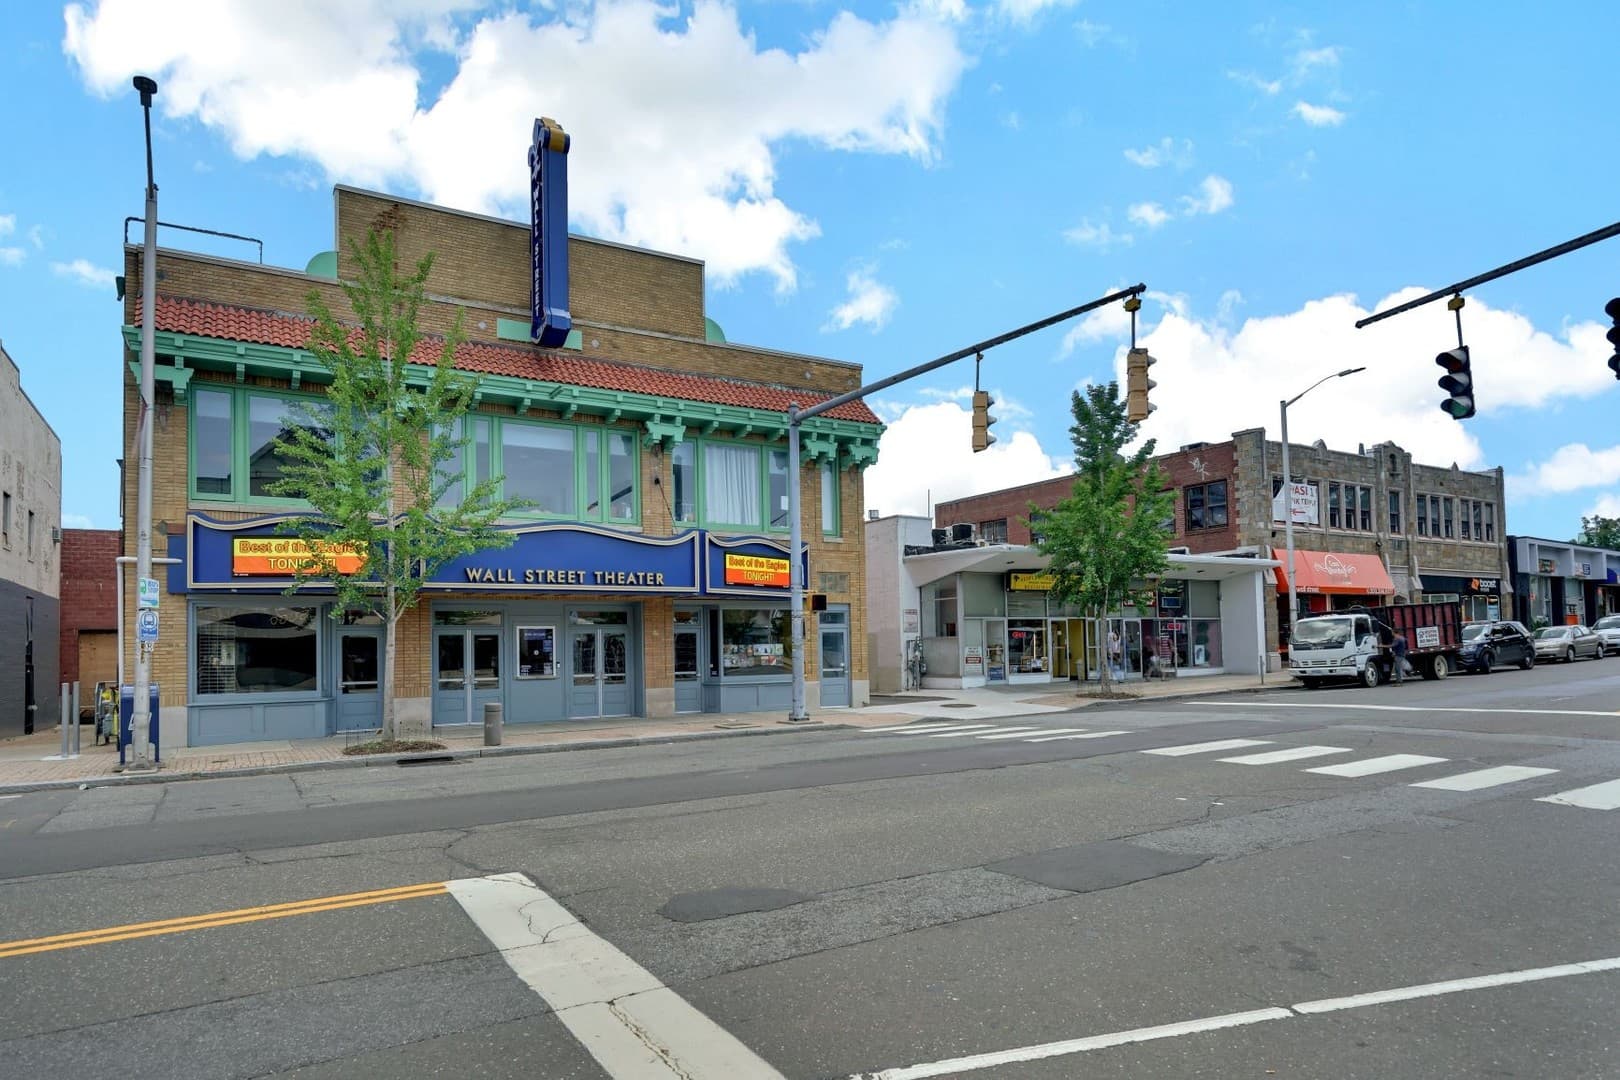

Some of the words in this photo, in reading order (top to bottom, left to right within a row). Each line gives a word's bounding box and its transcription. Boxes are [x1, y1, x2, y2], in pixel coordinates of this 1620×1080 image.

[239, 540, 272, 554] Best
[275, 541, 290, 554] of
[291, 541, 315, 554] th
[316, 542, 365, 556] Eagle
[268, 558, 336, 570] TONIT!
[745, 558, 753, 568] of
[466, 567, 516, 583] WALL
[525, 569, 587, 584] STREET
[595, 571, 666, 586] THEATER
